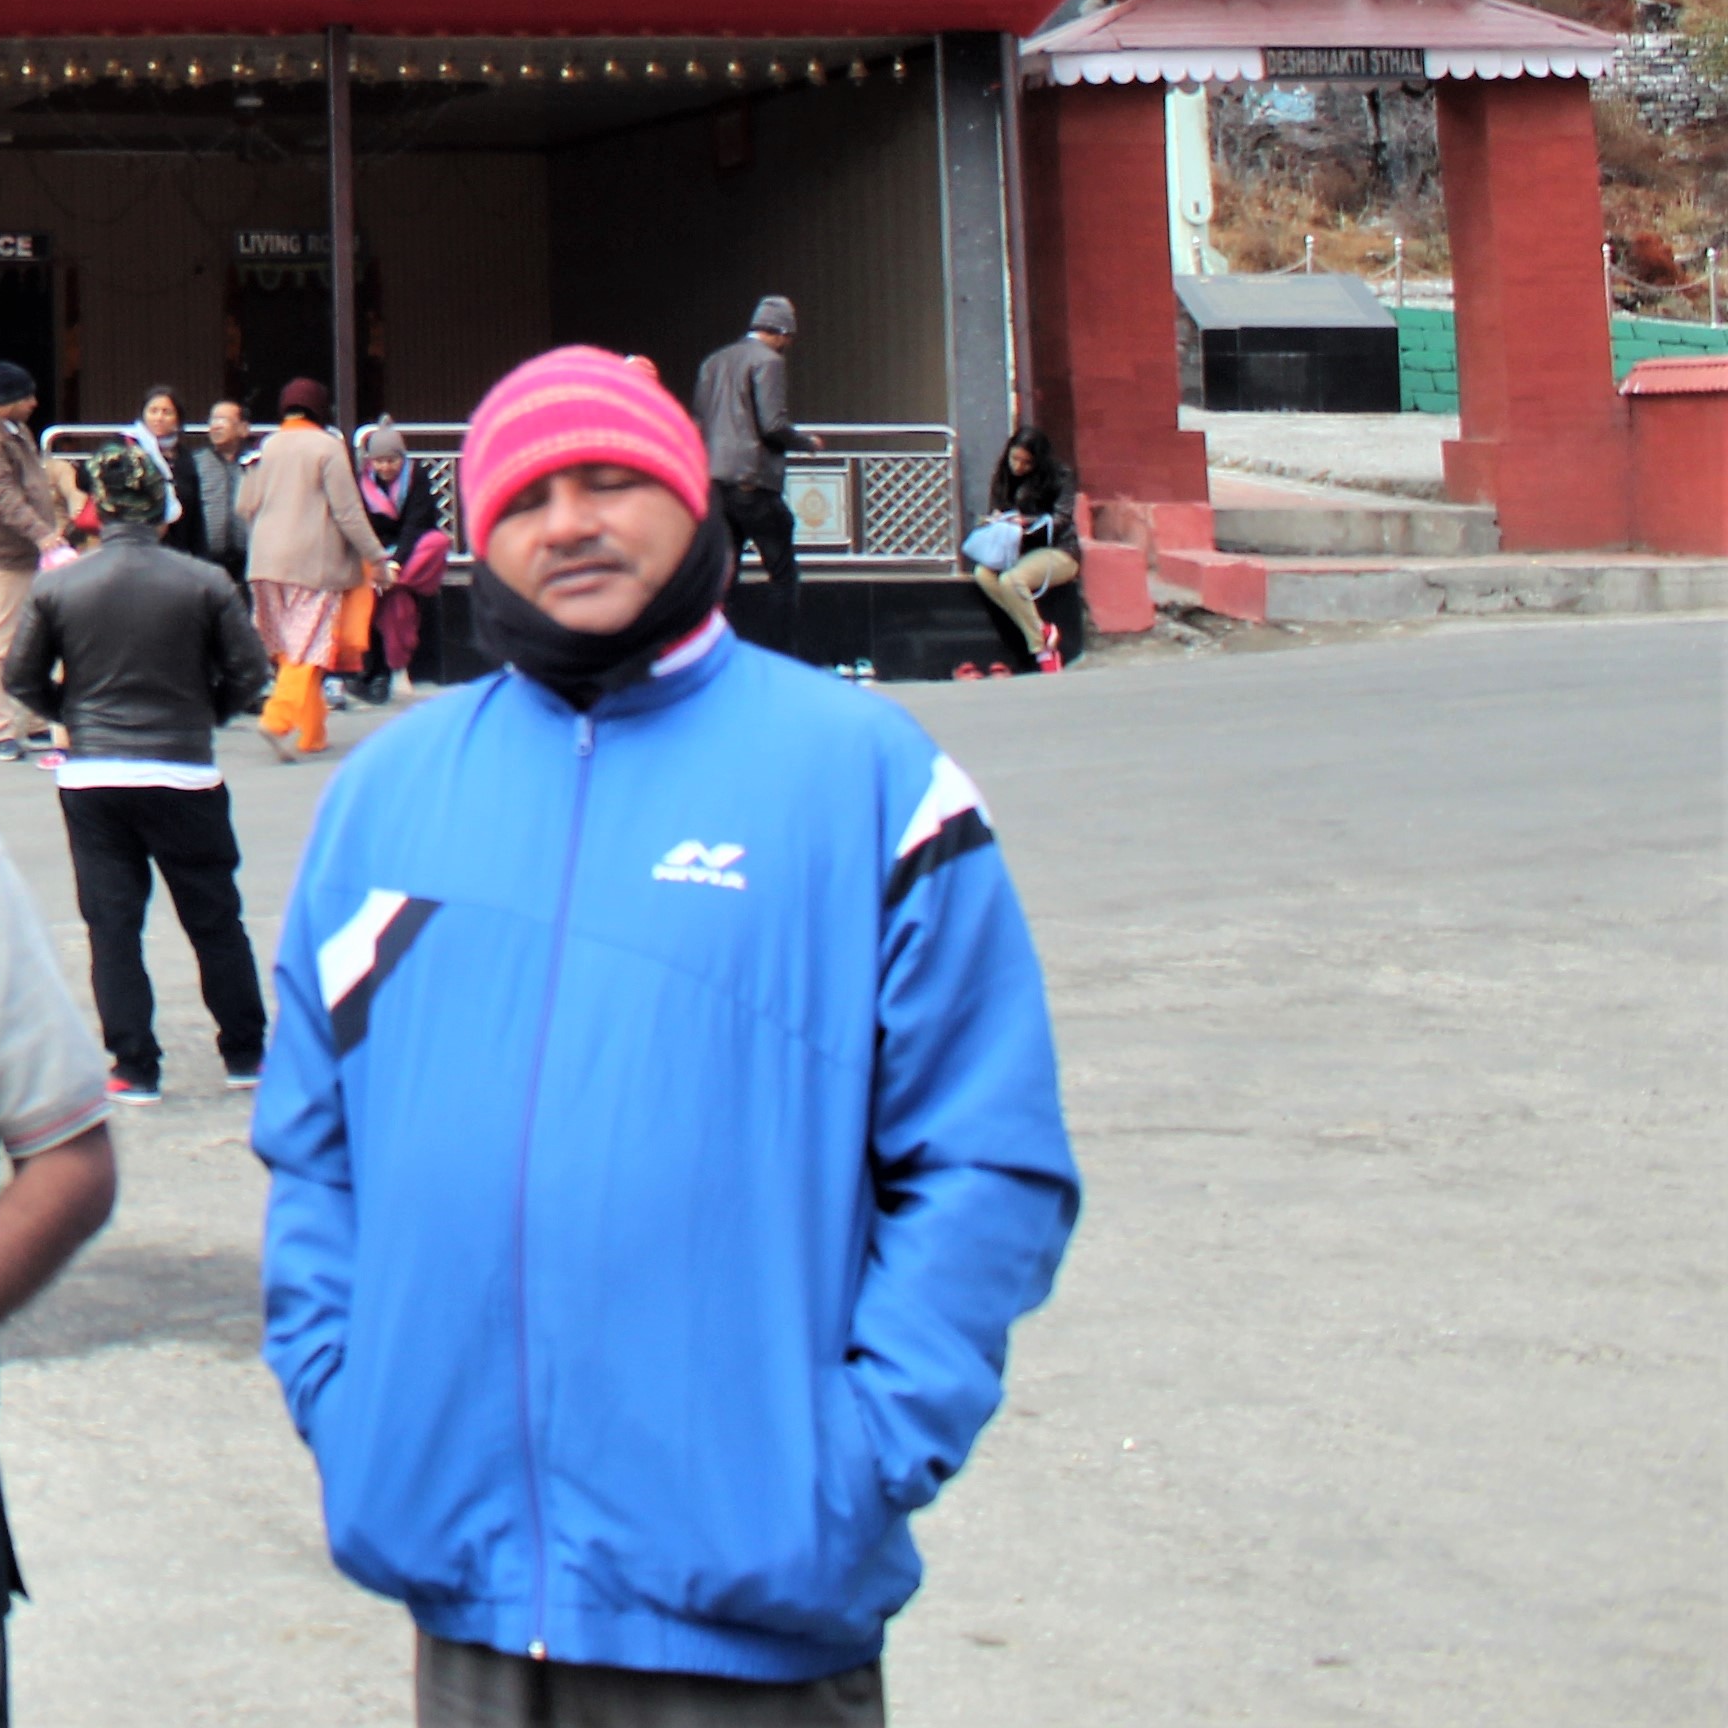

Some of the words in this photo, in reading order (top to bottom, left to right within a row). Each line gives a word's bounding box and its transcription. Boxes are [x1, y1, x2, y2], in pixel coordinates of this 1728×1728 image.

[1267, 49, 1366, 78] DESHBHAKTI
[1370, 50, 1424, 78] STHAL
[239, 233, 303, 255] LIVING
